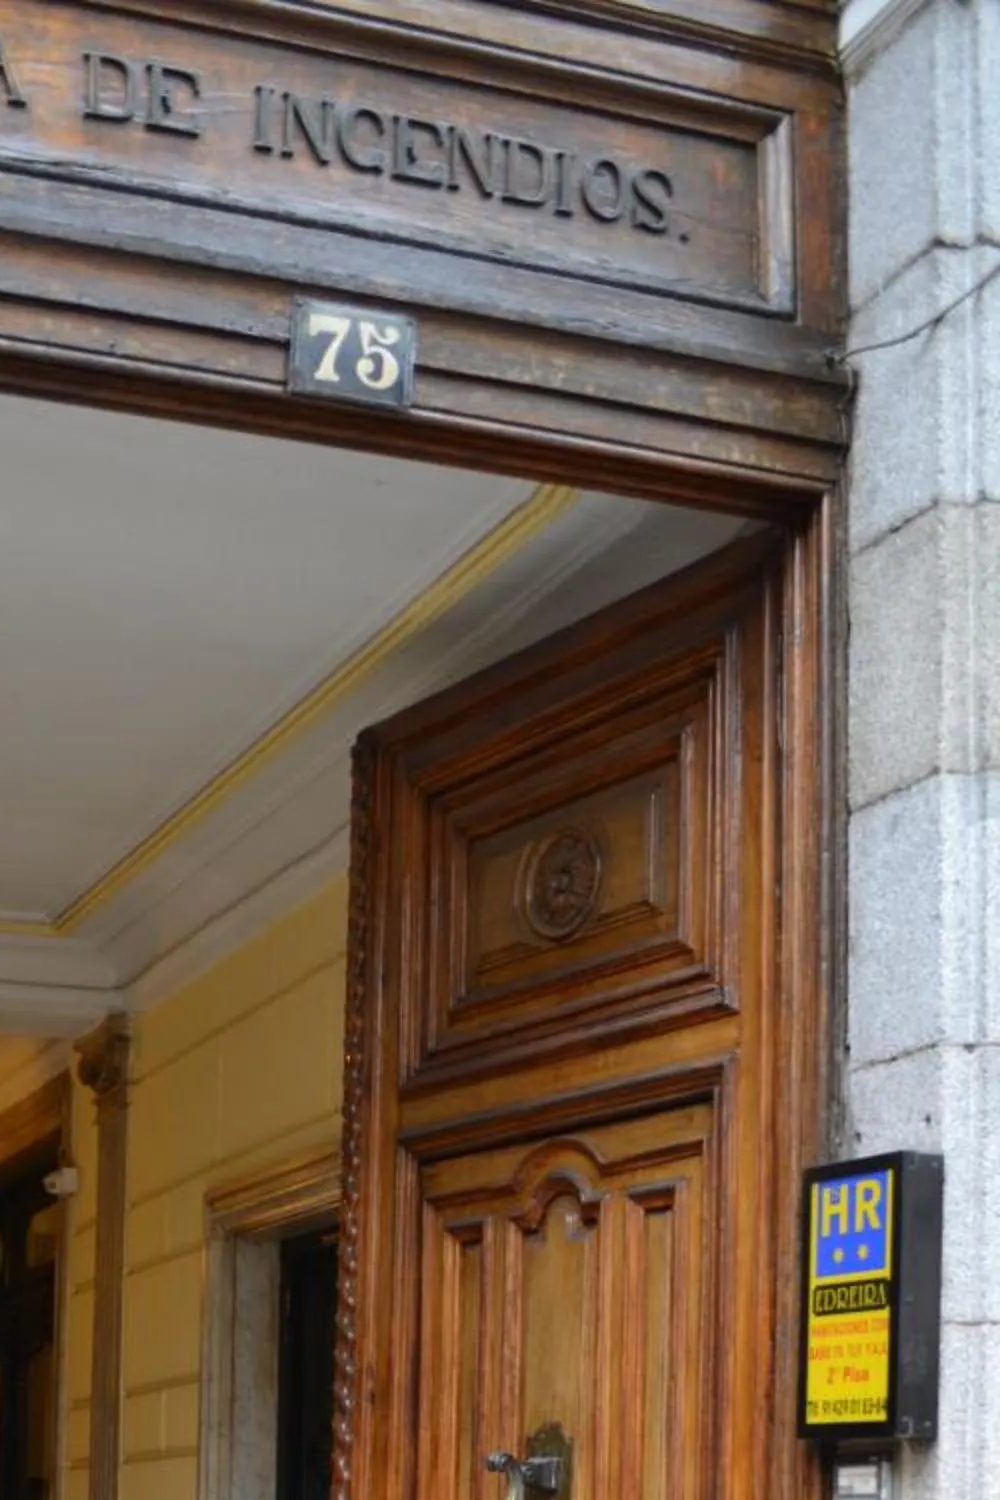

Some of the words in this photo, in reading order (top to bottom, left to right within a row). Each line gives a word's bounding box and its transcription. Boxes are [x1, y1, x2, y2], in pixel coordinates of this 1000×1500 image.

[82, 52, 201, 138] DE
[253, 85, 690, 243] INCENDIOS.
[308, 312, 400, 391] 75
[821, 1179, 882, 1238] HR
[815, 1282, 887, 1313] EDREIRA
